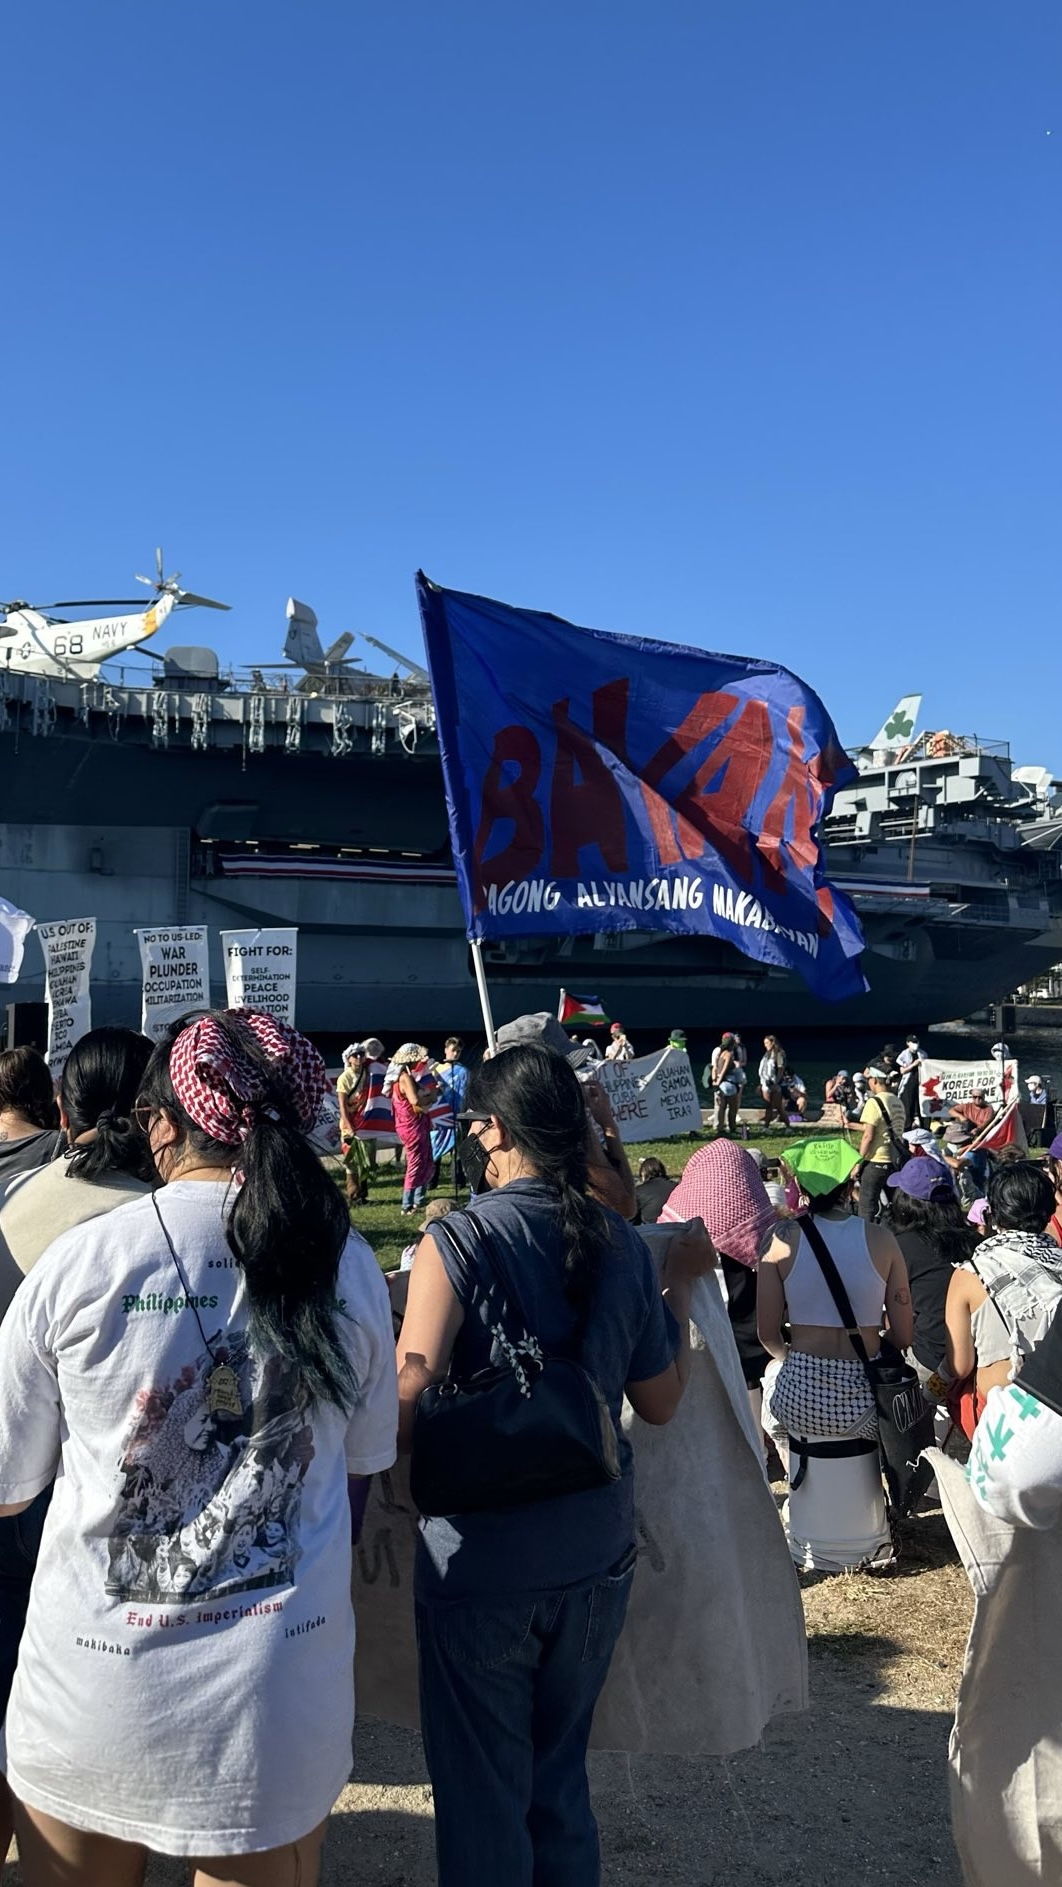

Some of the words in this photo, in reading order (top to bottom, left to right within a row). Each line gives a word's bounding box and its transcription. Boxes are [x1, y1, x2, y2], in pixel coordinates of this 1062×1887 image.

[92, 621, 128, 640] NAVY
[54, 634, 83, 656] 68
[482, 879, 561, 916] AGONG
[577, 876, 703, 911] ALYANSANG
[58, 924, 76, 936] OUT
[78, 922, 93, 934] OF:
[144, 935, 156, 943] NO
[158, 933, 170, 942] TO
[161, 946, 186, 960] WAR
[228, 946, 263, 957] FIGHT
[266, 946, 293, 956] FOR:
[48, 961, 85, 978] HILIPPINES
[149, 962, 198, 978] PLUNDER
[145, 978, 202, 992] OCCUPATION
[232, 973, 290, 982] DETERMINATION
[244, 982, 278, 993] PEACE
[145, 992, 204, 1005] MILITARIZATION
[234, 993, 290, 1004] LIVELIHOOD
[656, 1065, 690, 1080] GUAHAN
[661, 1077, 692, 1093] SAMOA
[942, 1079, 974, 1091] KOREA
[976, 1076, 995, 1087] FOR
[612, 1090, 637, 1106] CUBA
[660, 1091, 694, 1107] MEXICO
[945, 1086, 996, 1100] PALESNE
[121, 1292, 219, 1315] Philippines
[126, 1611, 153, 1627] End
[158, 1614, 190, 1628] U.S.
